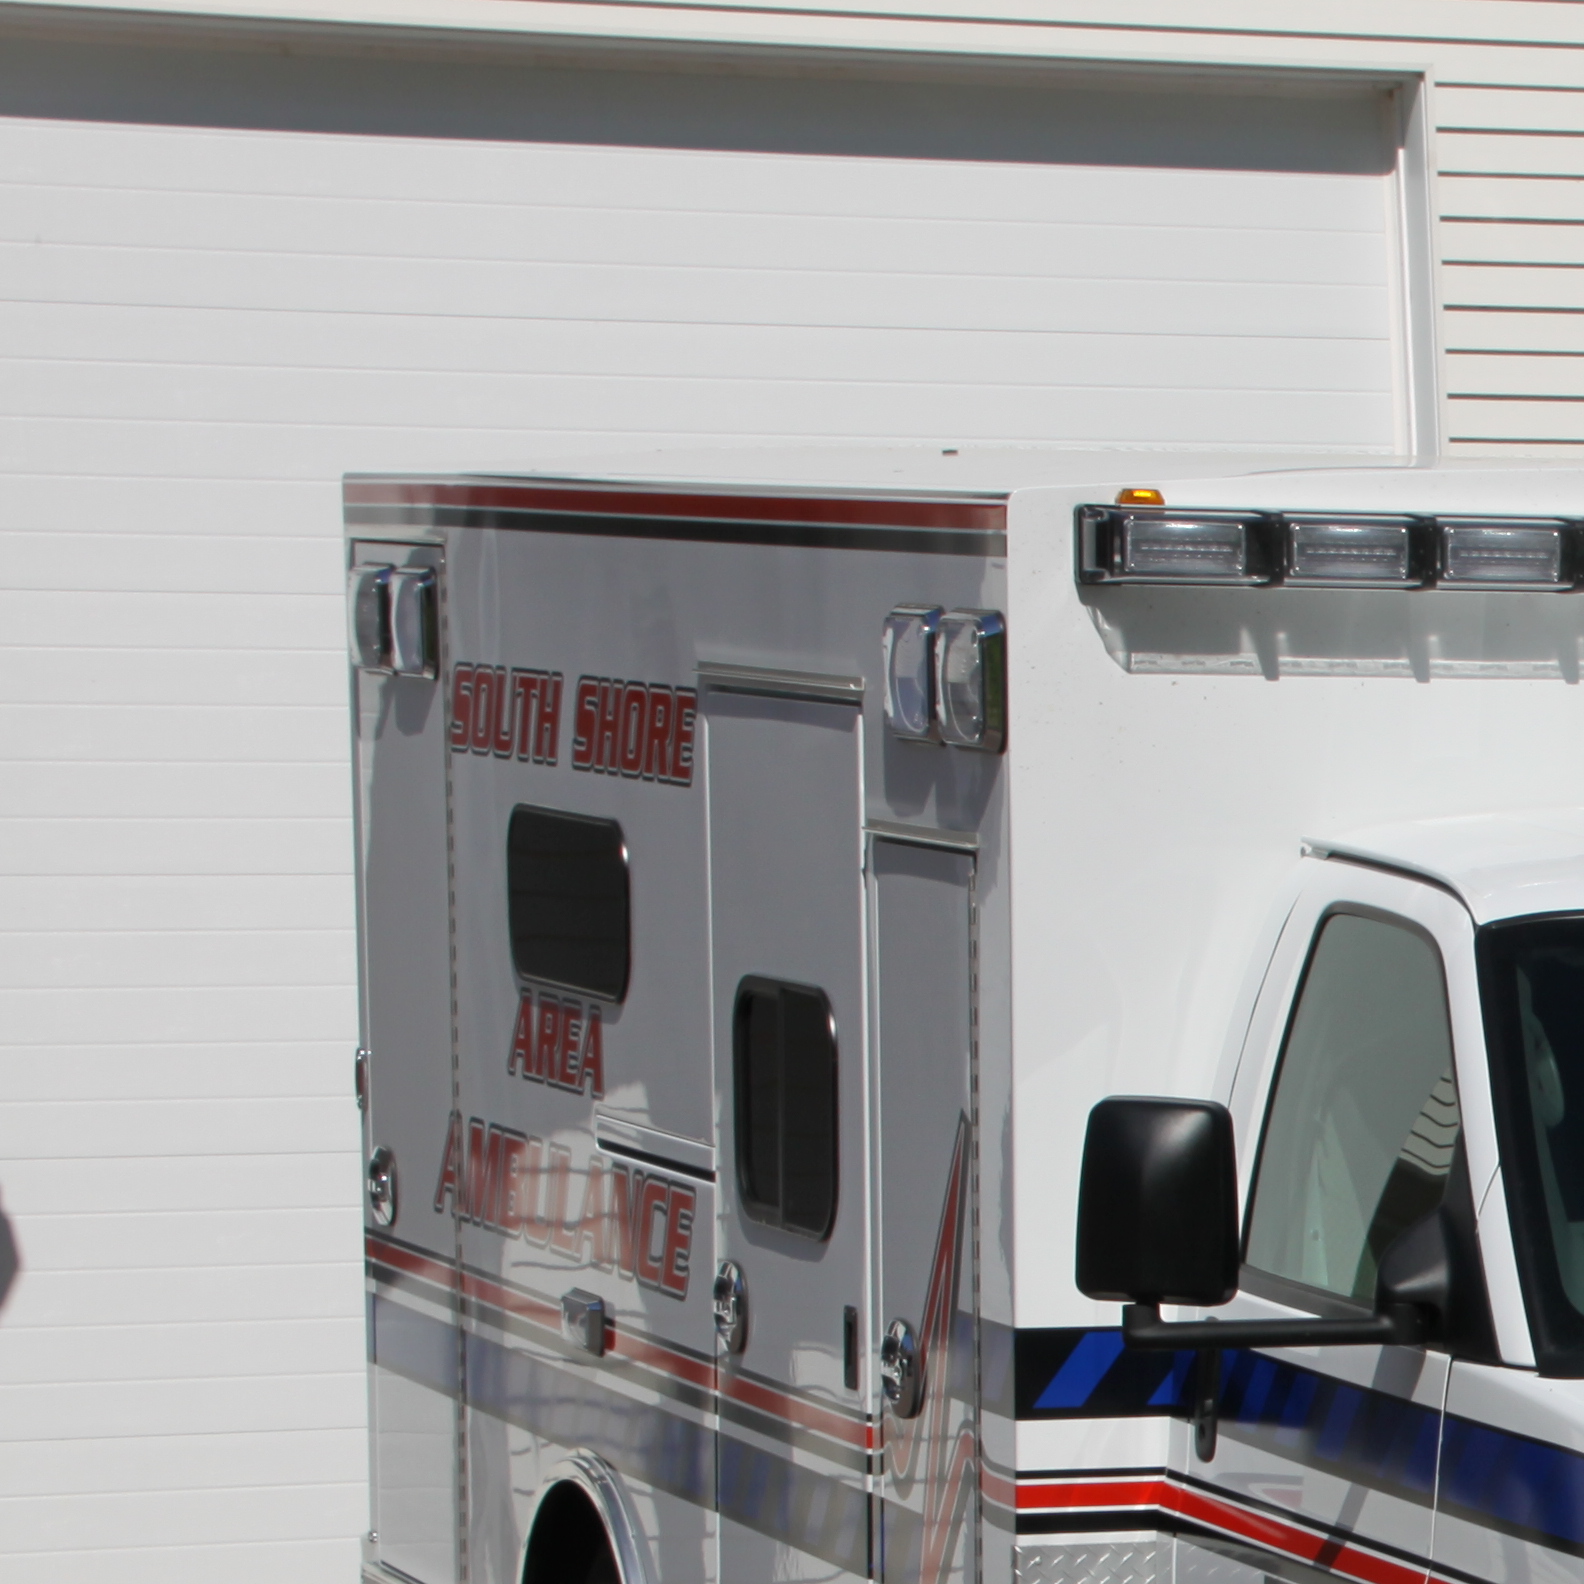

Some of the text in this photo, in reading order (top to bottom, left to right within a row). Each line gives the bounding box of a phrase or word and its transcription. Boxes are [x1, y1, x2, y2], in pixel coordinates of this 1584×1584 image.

[450, 661, 697, 788] SOUTH SHORE
[507, 986, 604, 1101] AREA
[433, 1109, 696, 1302] AMBULANCE
